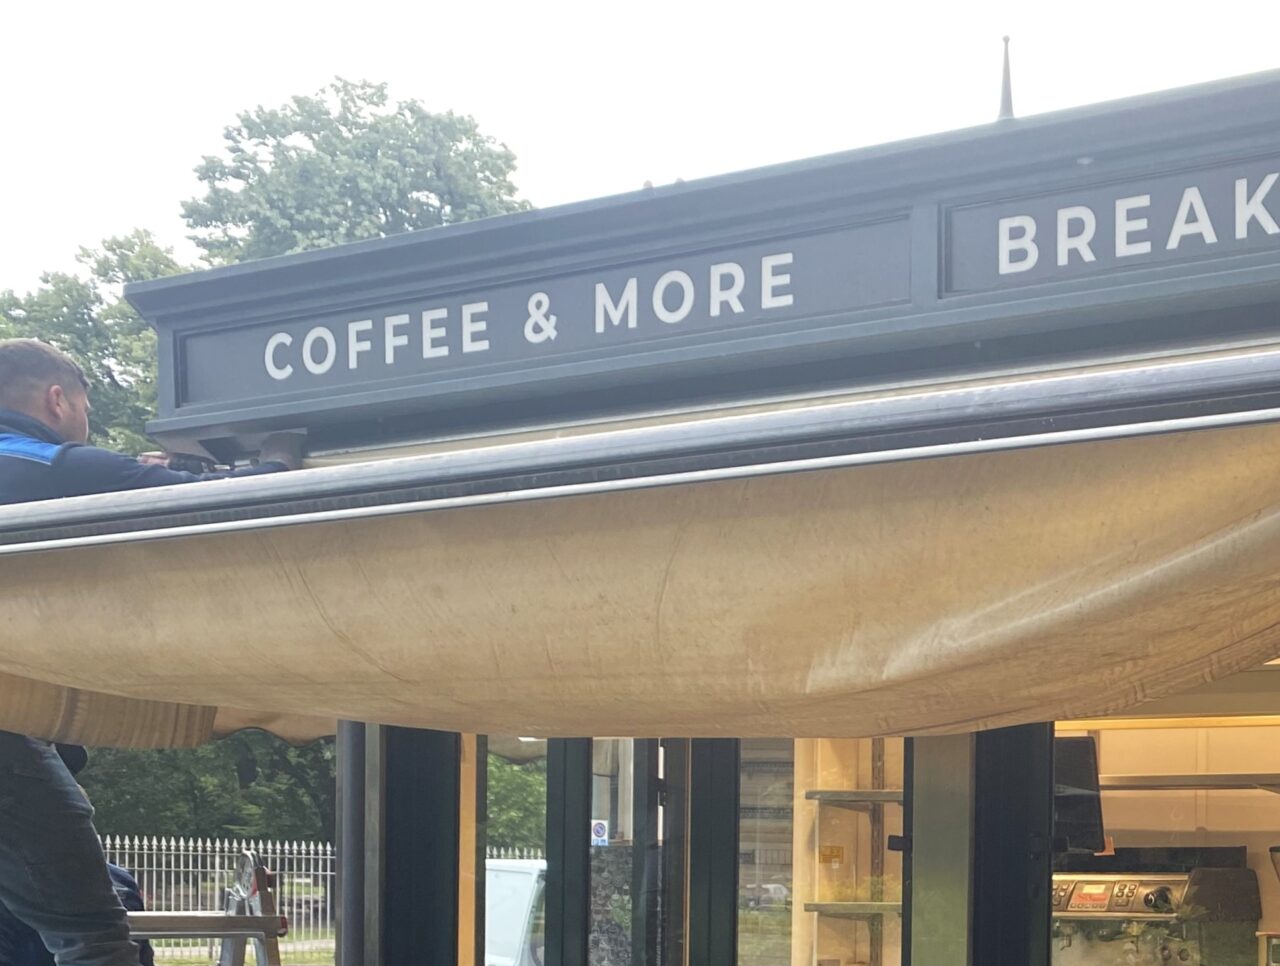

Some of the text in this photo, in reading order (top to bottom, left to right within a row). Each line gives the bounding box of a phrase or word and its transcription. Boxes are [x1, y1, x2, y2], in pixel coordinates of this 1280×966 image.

[264, 252, 794, 380] COFFEE & MORE
